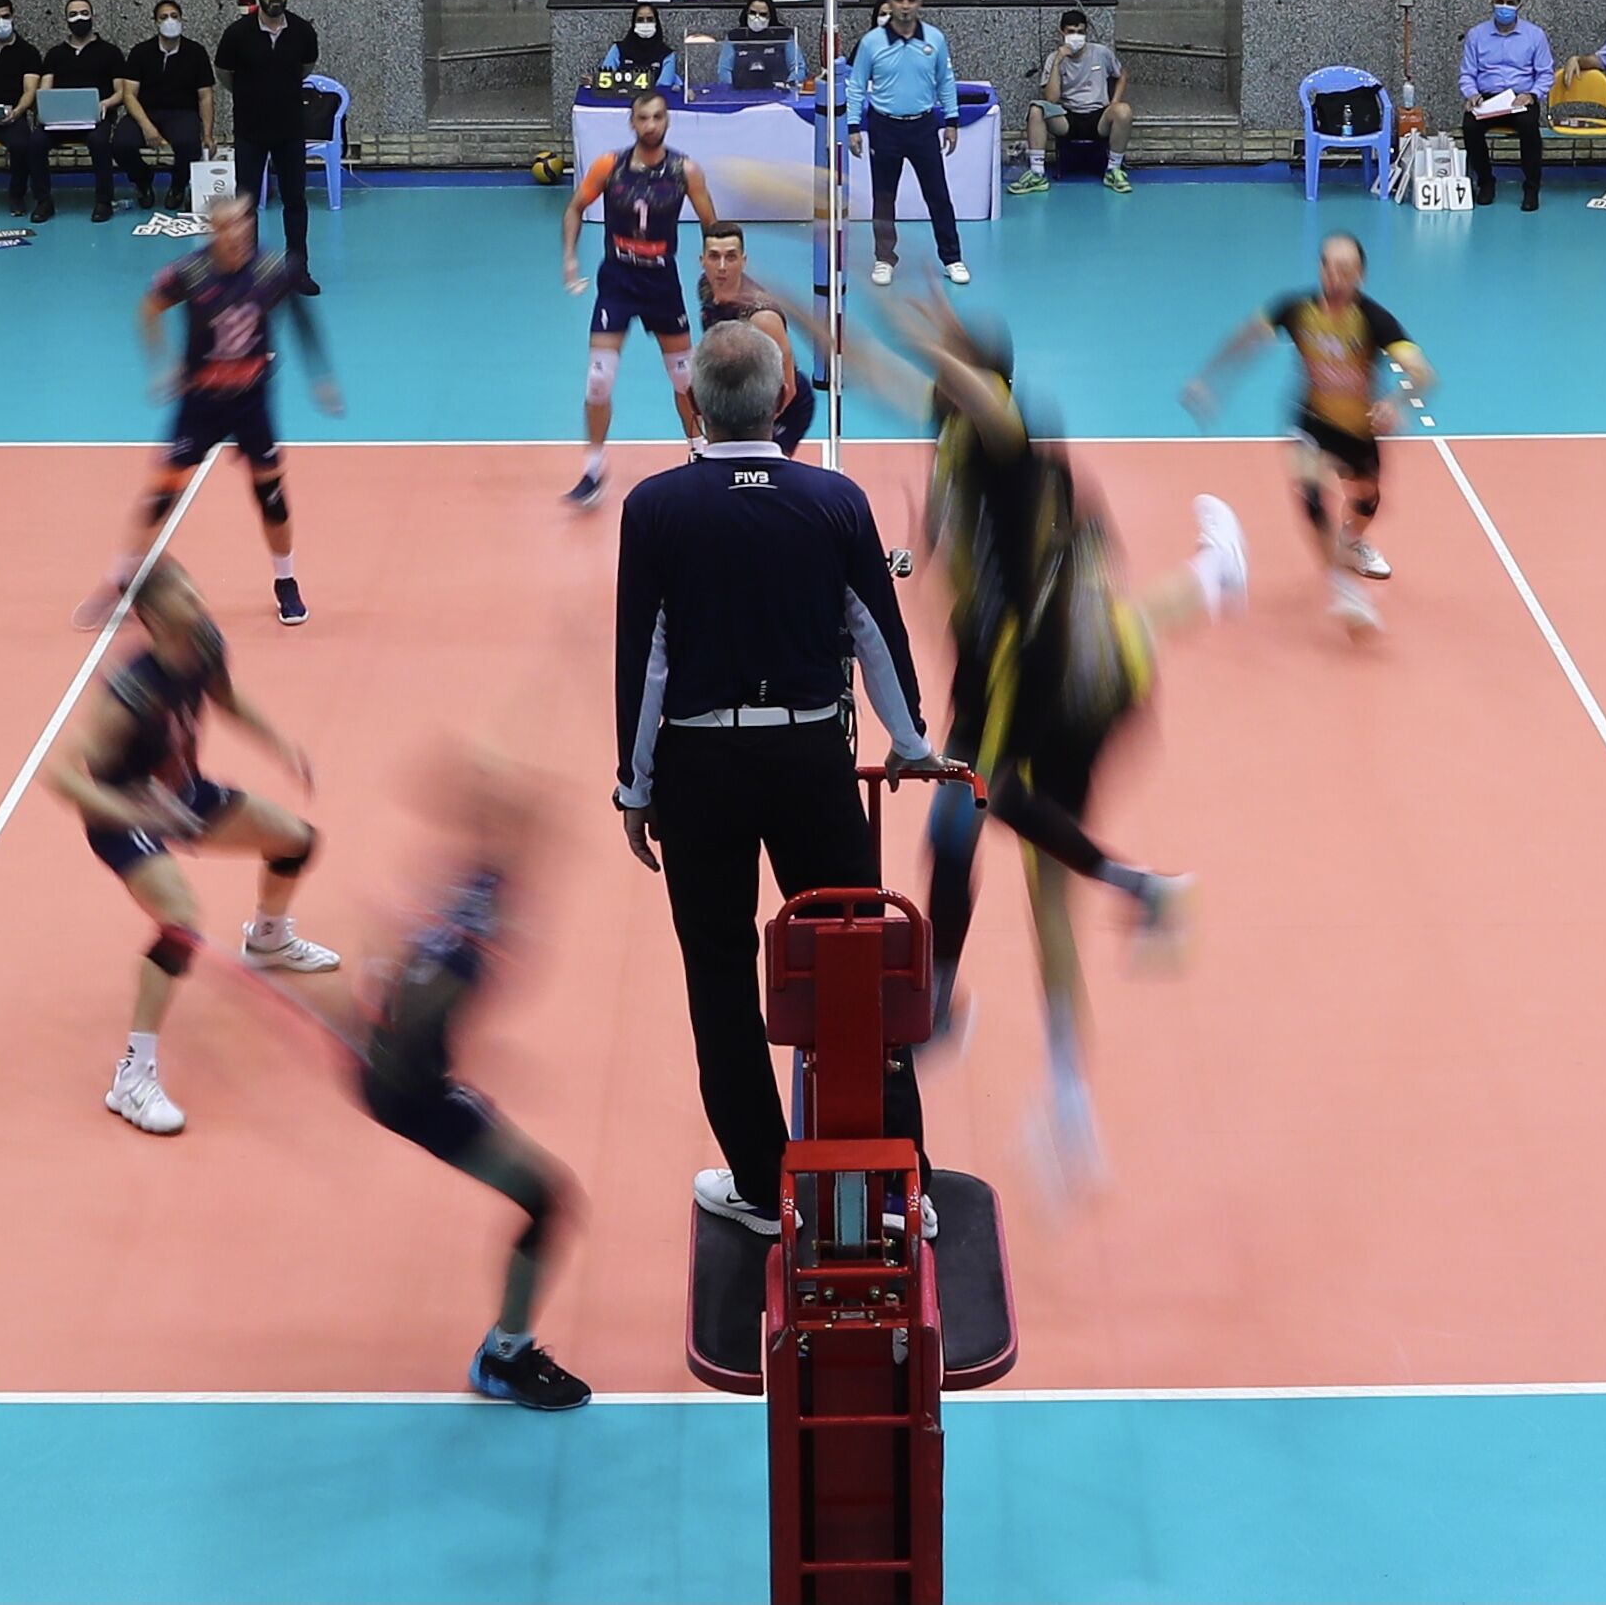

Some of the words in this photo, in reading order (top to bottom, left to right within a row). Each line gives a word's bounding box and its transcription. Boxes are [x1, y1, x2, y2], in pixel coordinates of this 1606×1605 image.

[598, 72, 612, 89] 5
[634, 73, 649, 89] 4
[1421, 183, 1441, 206] 15
[1455, 182, 1466, 205] 4
[633, 198, 648, 231] 1
[734, 471, 769, 484] FIVB
